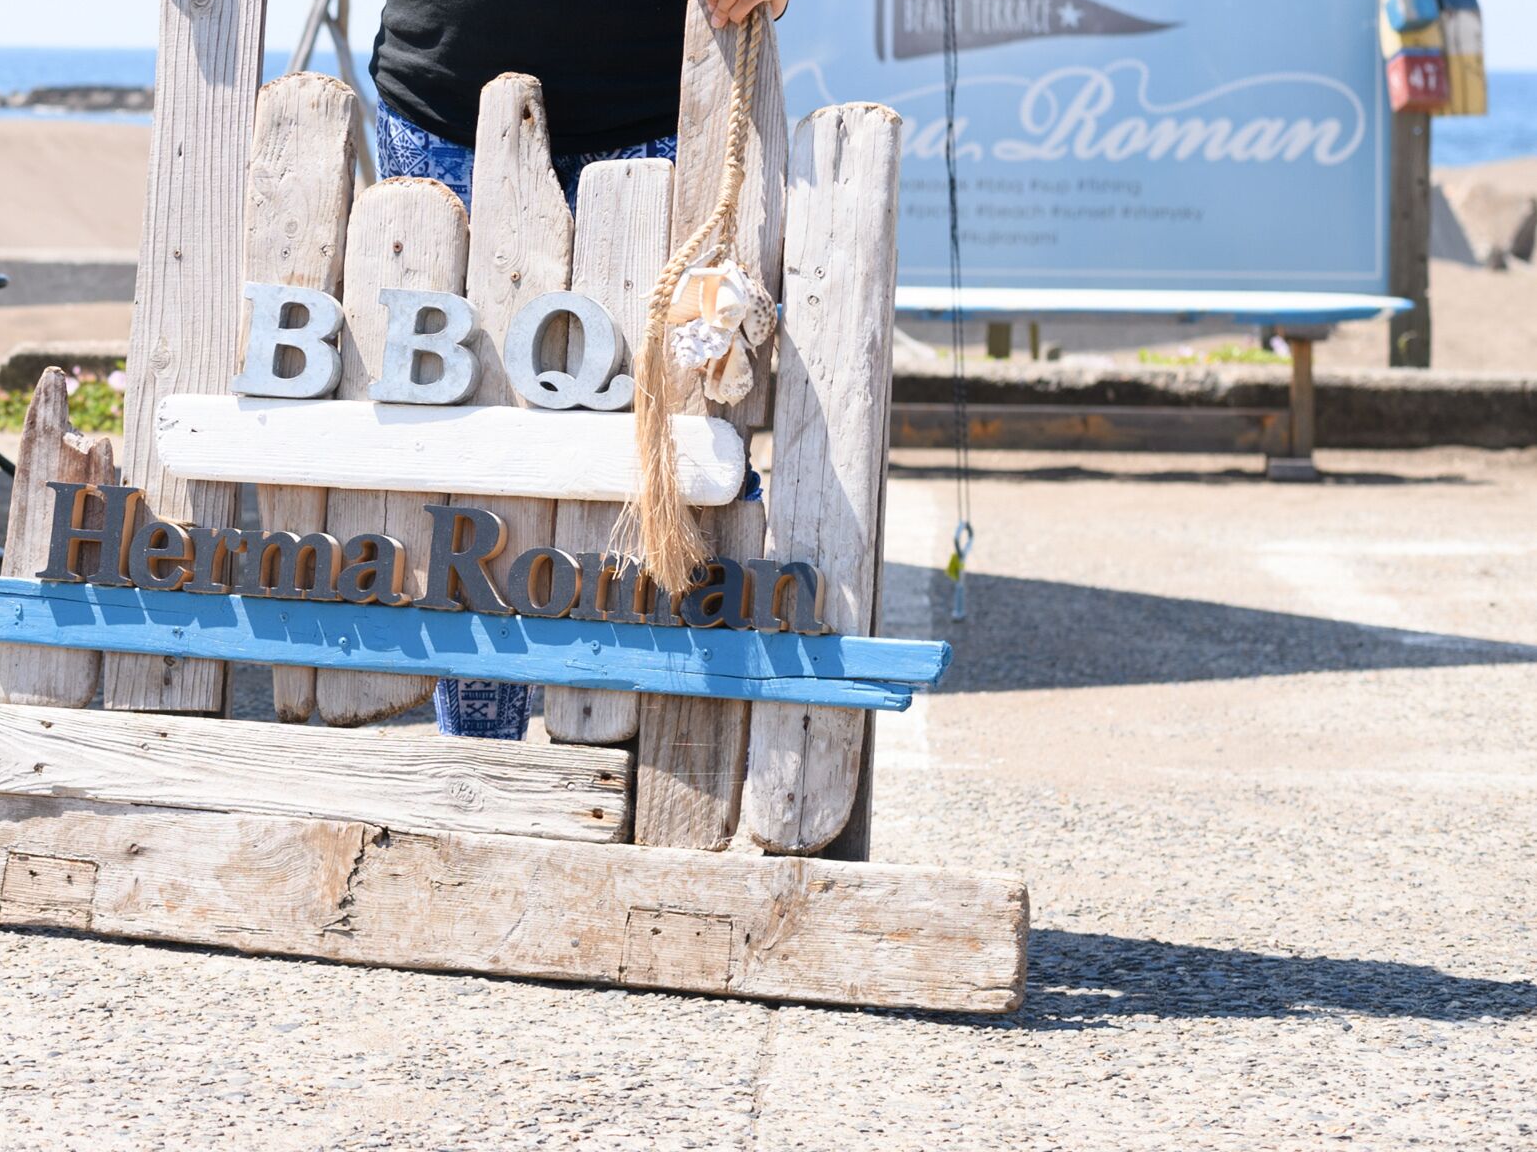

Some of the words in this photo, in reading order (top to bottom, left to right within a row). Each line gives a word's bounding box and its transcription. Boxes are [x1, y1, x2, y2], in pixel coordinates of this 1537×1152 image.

[991, 61, 1365, 167] Roman
[230, 281, 635, 411] BBQ
[35, 480, 412, 607] Herma
[411, 503, 832, 634] Roman
